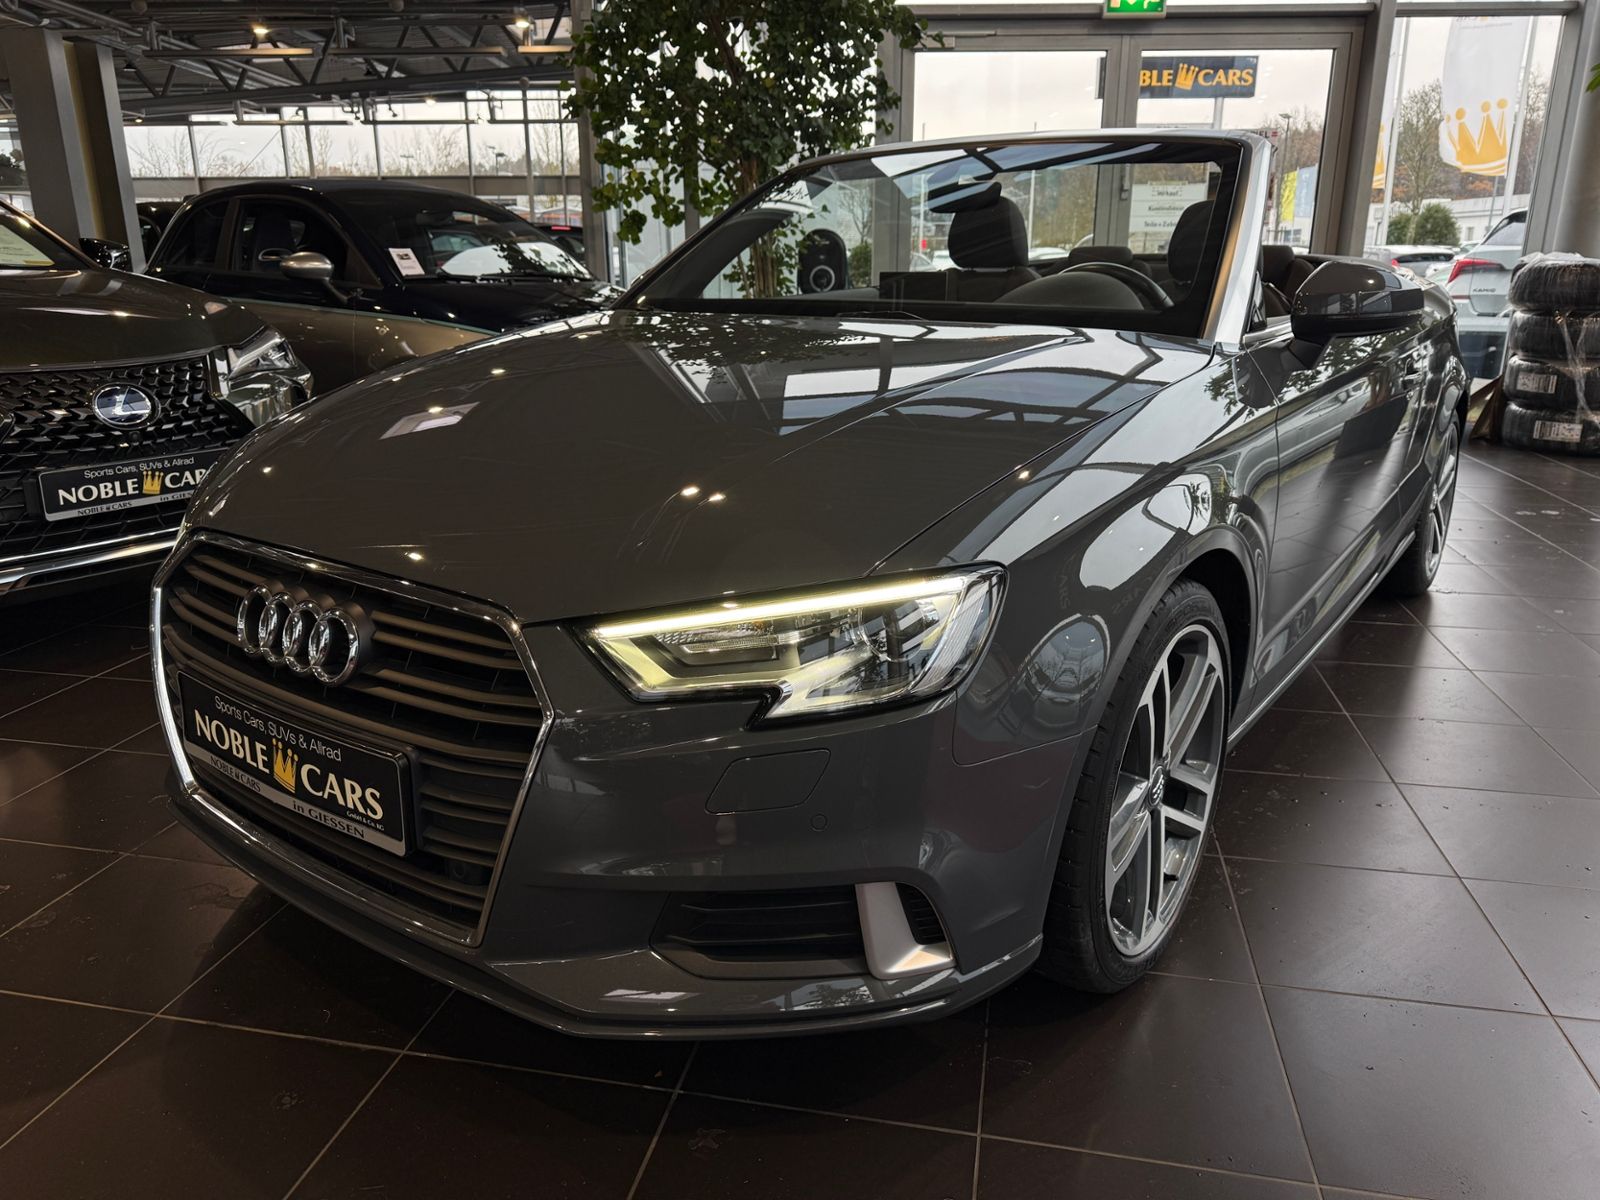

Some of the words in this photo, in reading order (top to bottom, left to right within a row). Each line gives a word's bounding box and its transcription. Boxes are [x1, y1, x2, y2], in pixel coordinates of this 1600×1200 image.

[1197, 68, 1254, 87] CARS
[84, 467, 114, 479] Sports
[139, 461, 163, 472] SUVs
[164, 460, 171, 468] &
[172, 456, 195, 466] Allrad
[57, 478, 140, 506] NOBLE
[111, 501, 132, 511] CARS
[214, 696, 243, 721] Sports
[243, 710, 268, 735] Cars,
[268, 721, 297, 745] SUVs
[298, 734, 307, 749] &
[309, 737, 342, 762] Allrad
[194, 709, 271, 774] NOBLE
[300, 762, 384, 820] CARS
[210, 756, 236, 780] NOBLE
[239, 773, 261, 793] CARS
[292, 800, 305, 813] in
[308, 804, 366, 839] GIESSEN
